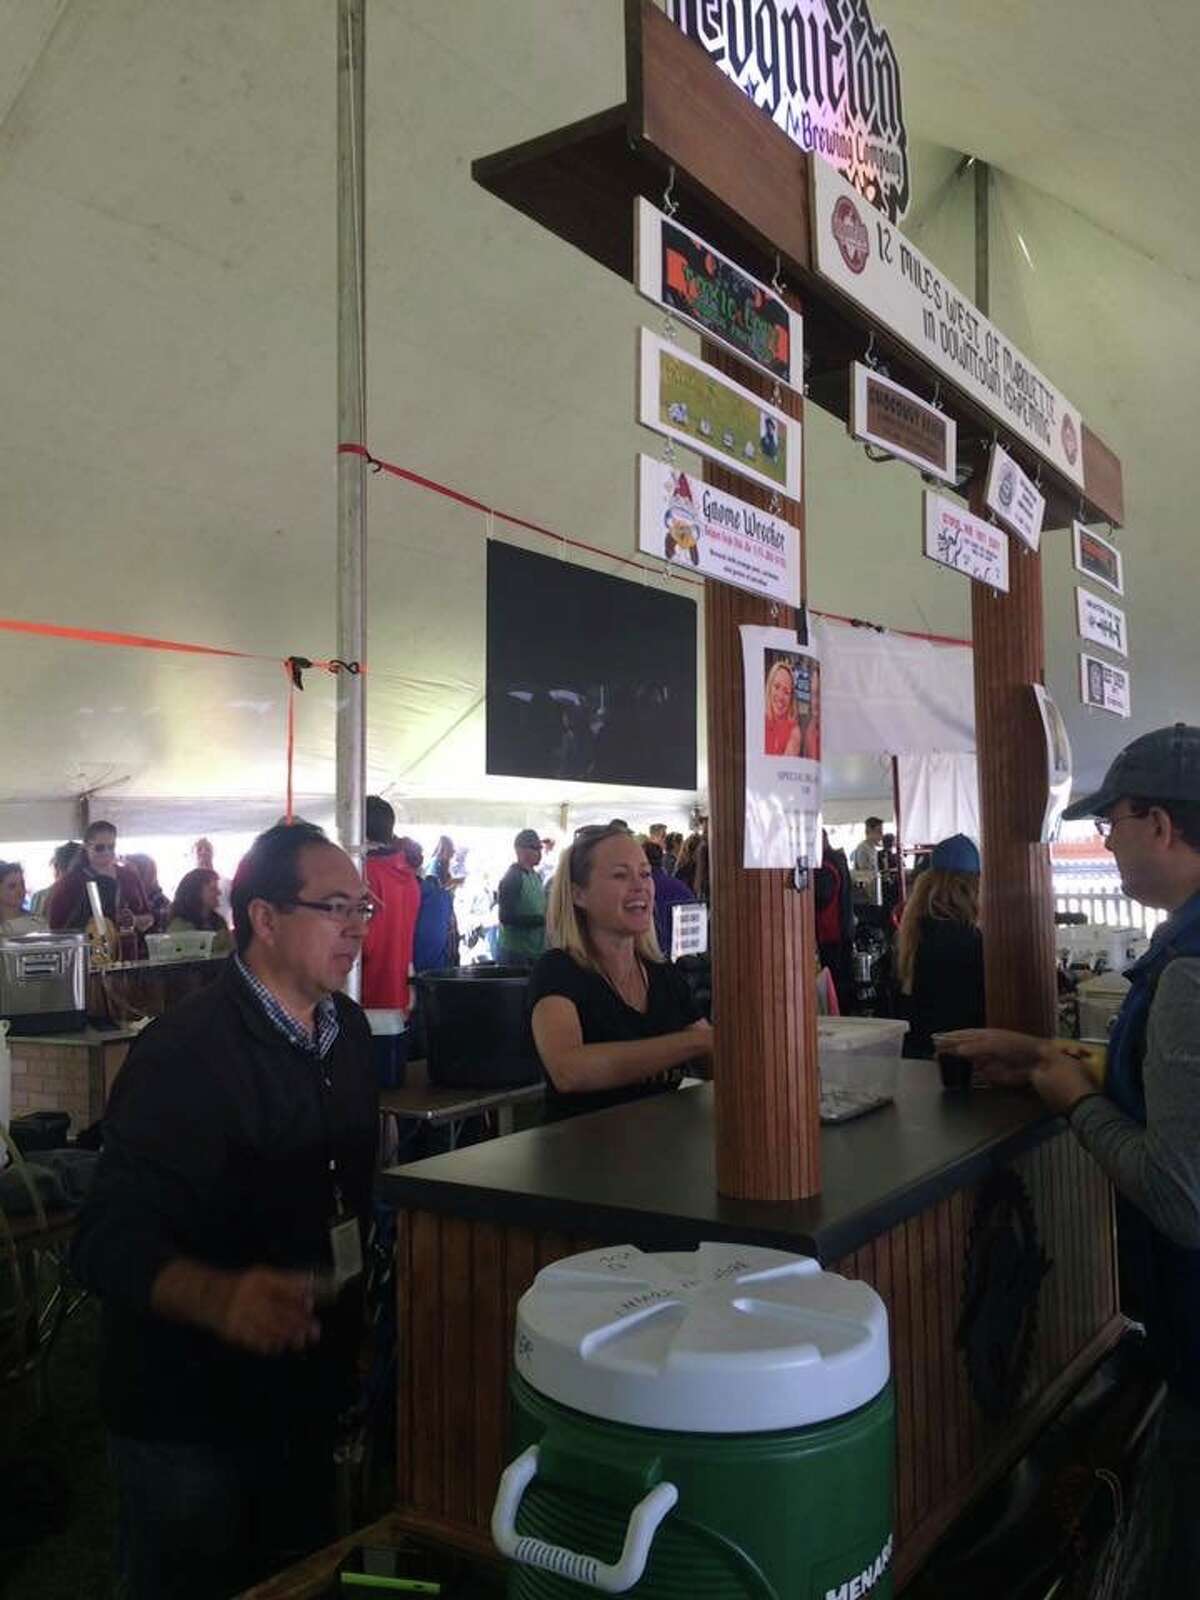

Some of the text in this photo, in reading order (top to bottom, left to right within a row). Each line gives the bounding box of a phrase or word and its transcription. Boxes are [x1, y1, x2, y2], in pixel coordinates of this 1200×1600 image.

[801, 110, 902, 186] Brewing Company
[876, 221, 894, 264] 12
[900, 243, 942, 311] MILES
[985, 330, 1001, 374] OF
[702, 489, 741, 531] Gnome
[742, 508, 786, 552] Wrecker
